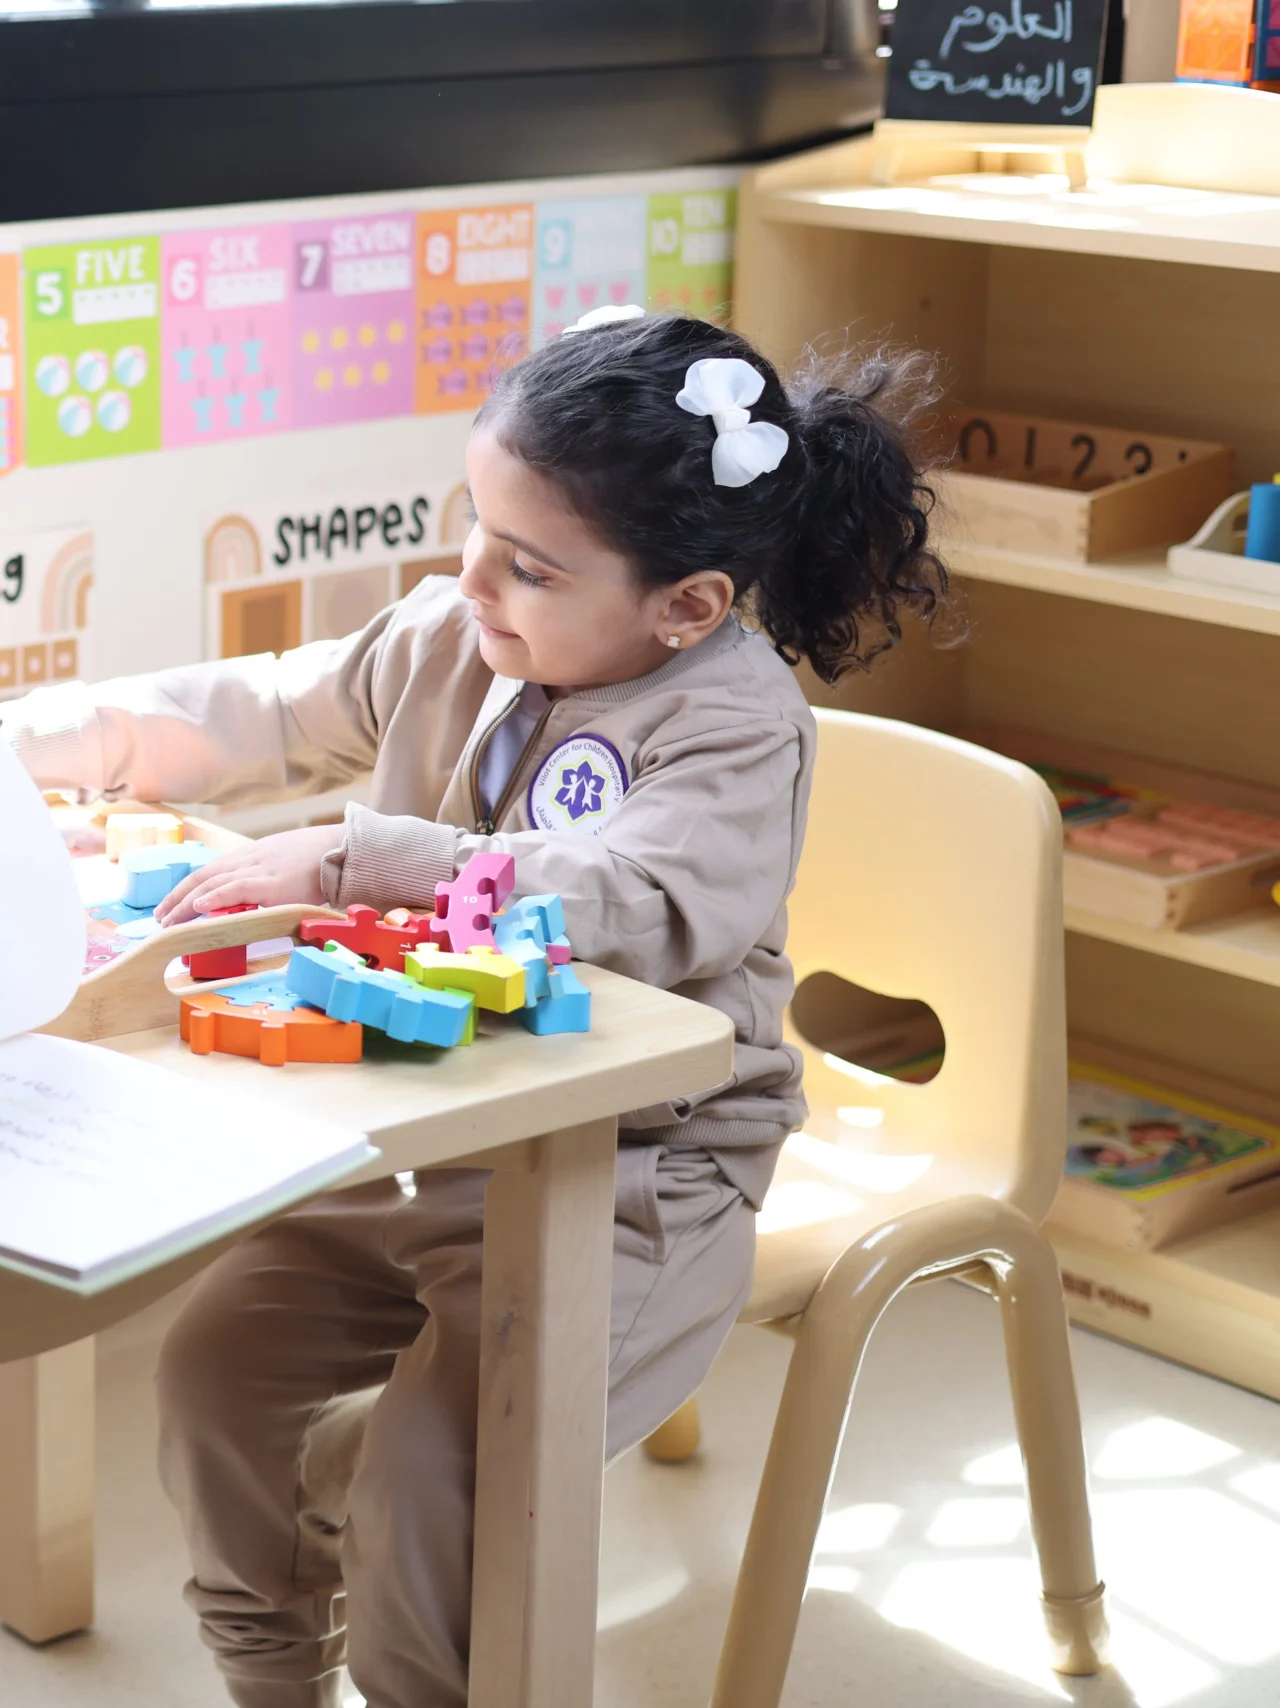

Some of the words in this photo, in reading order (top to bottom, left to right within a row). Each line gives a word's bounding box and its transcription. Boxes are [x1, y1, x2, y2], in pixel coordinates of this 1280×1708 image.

[939, 0, 1073, 60] العلوم
[331, 220, 411, 256] SEVEN
[457, 210, 531, 249] EIGHT
[544, 227, 566, 264] 9
[76, 245, 146, 285] FIVE
[208, 236, 261, 271] SIX
[300, 243, 324, 287] 7
[425, 233, 451, 275] 8
[36, 271, 63, 316] 5
[171, 259, 198, 300] 6
[549, 747, 570, 768] Center
[571, 743, 582, 752] for
[583, 742, 609, 762] Children
[462, 895, 478, 904] 10
